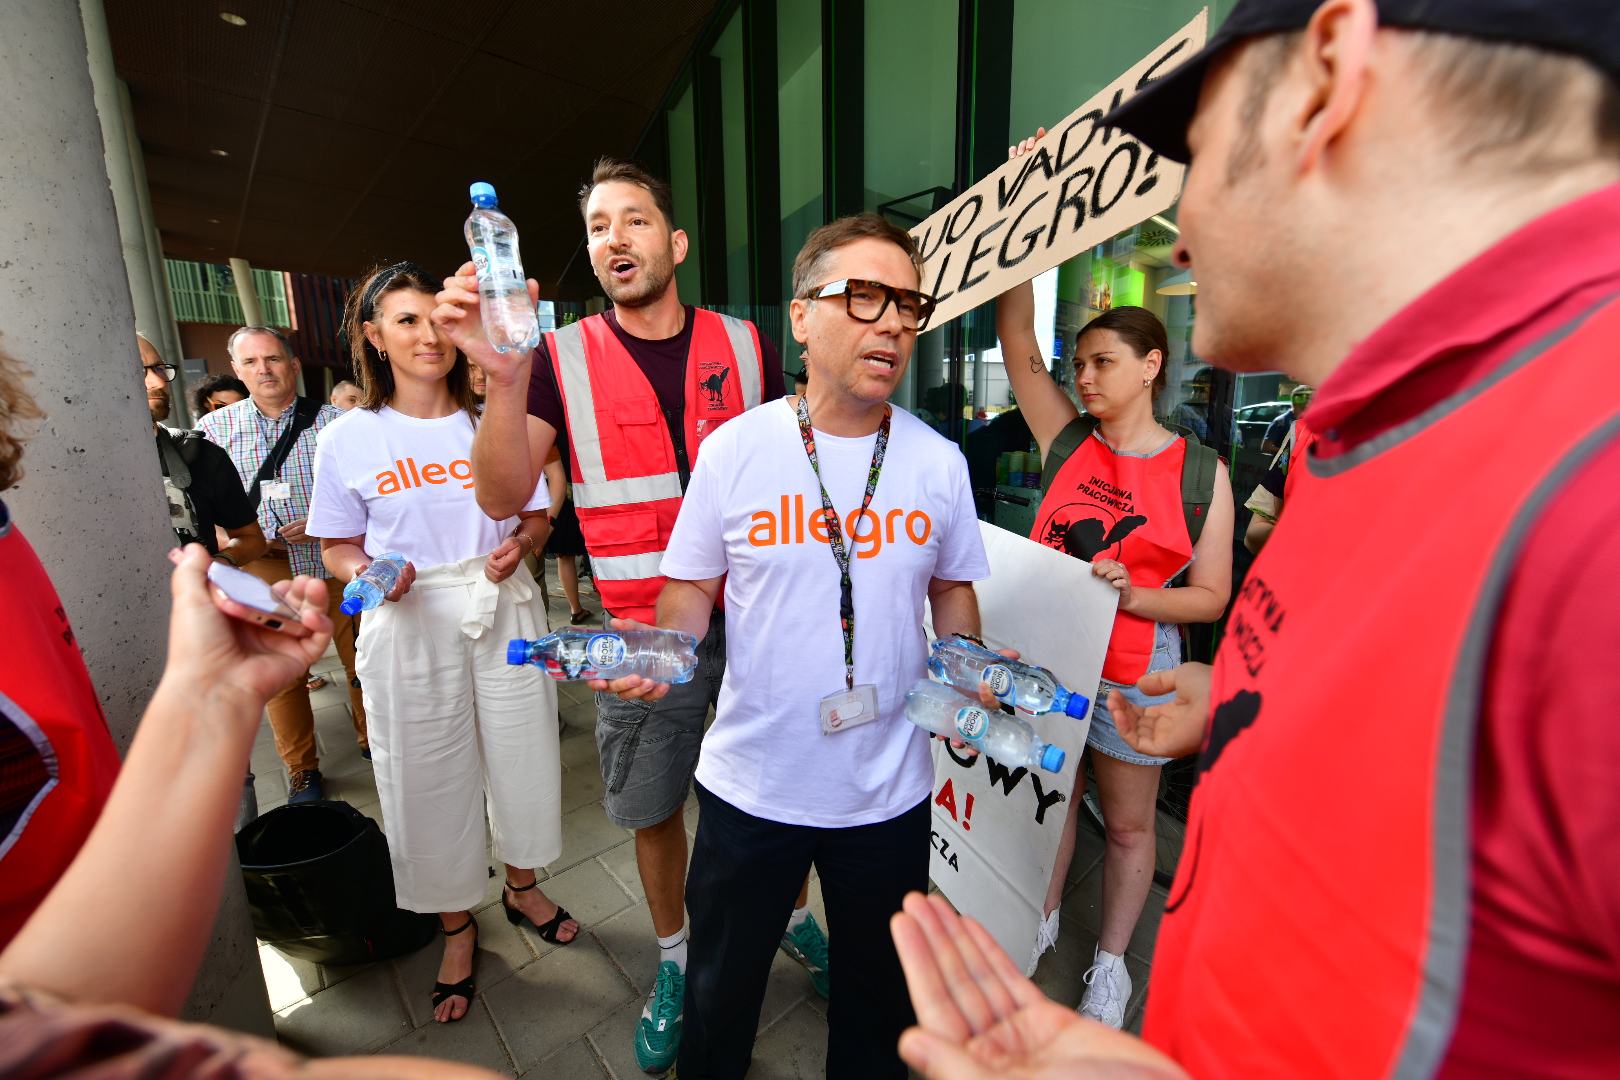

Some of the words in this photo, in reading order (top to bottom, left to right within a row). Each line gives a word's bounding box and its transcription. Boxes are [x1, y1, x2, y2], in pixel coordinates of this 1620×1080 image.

[912, 194, 984, 264] UO
[747, 493, 932, 559] allegro
[599, 636, 609, 666] KROPLA
